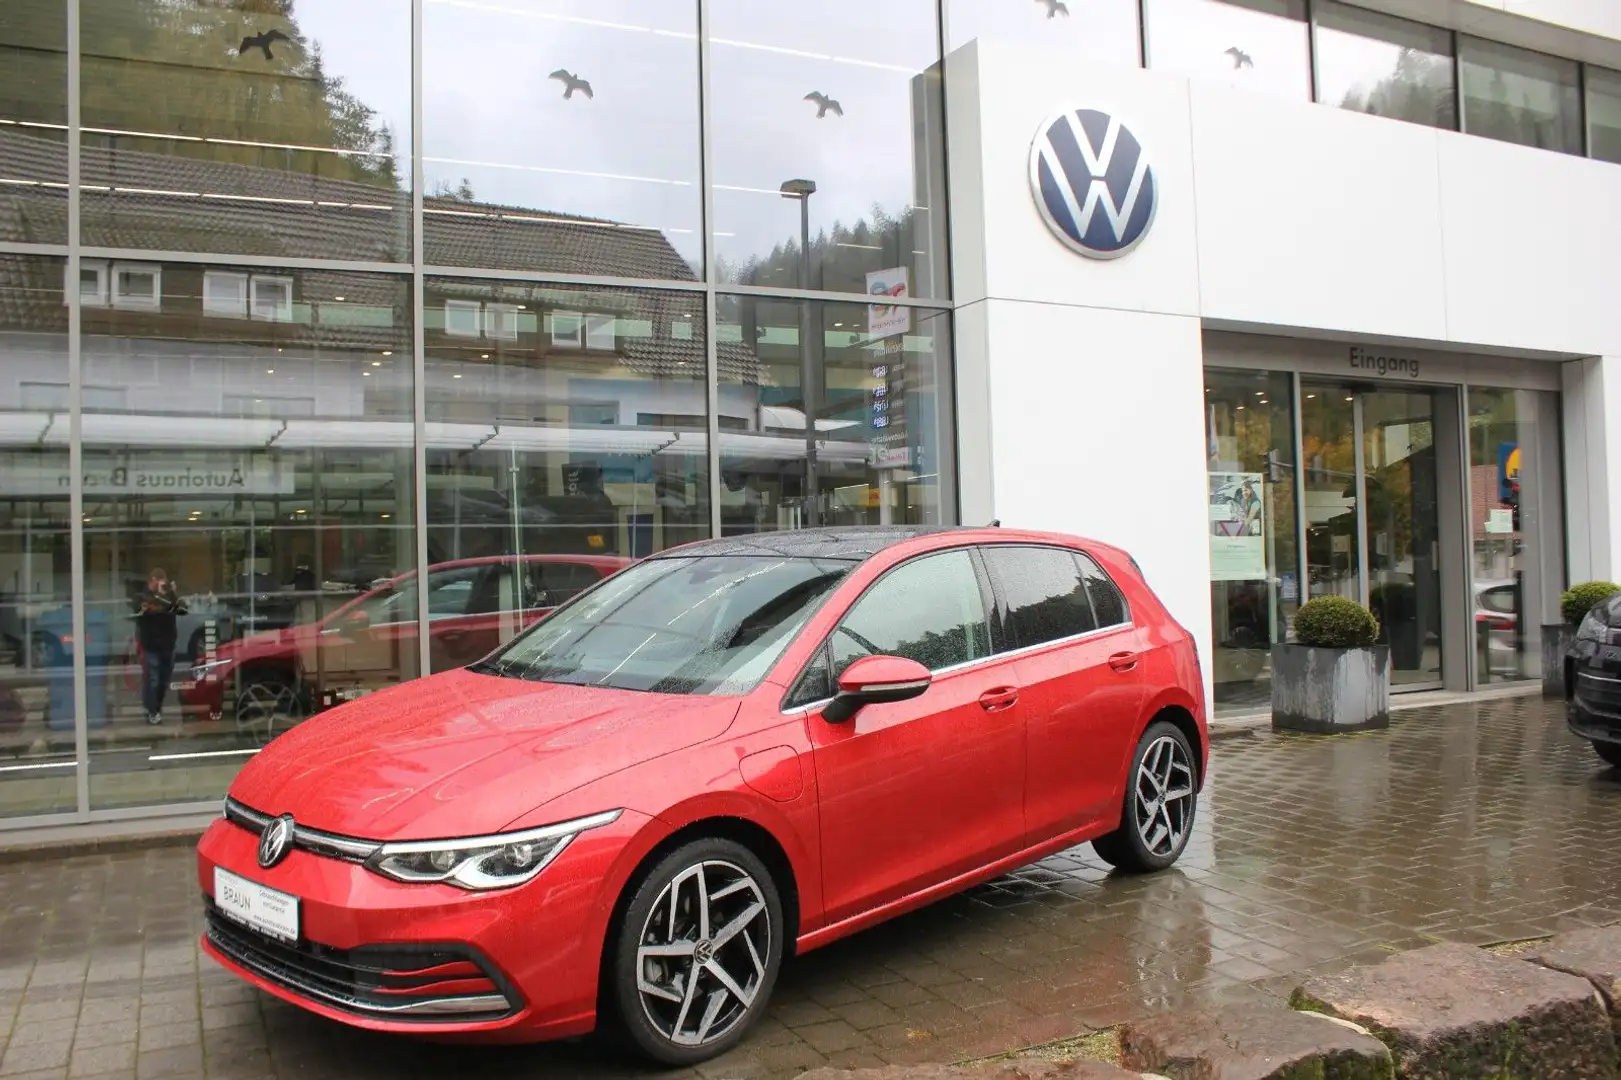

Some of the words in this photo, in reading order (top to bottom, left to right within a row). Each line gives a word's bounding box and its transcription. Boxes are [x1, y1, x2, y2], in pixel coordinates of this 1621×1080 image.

[1036, 107, 1152, 246] VW
[1349, 347, 1419, 378] Eingang
[223, 885, 251, 910] BRAUN
